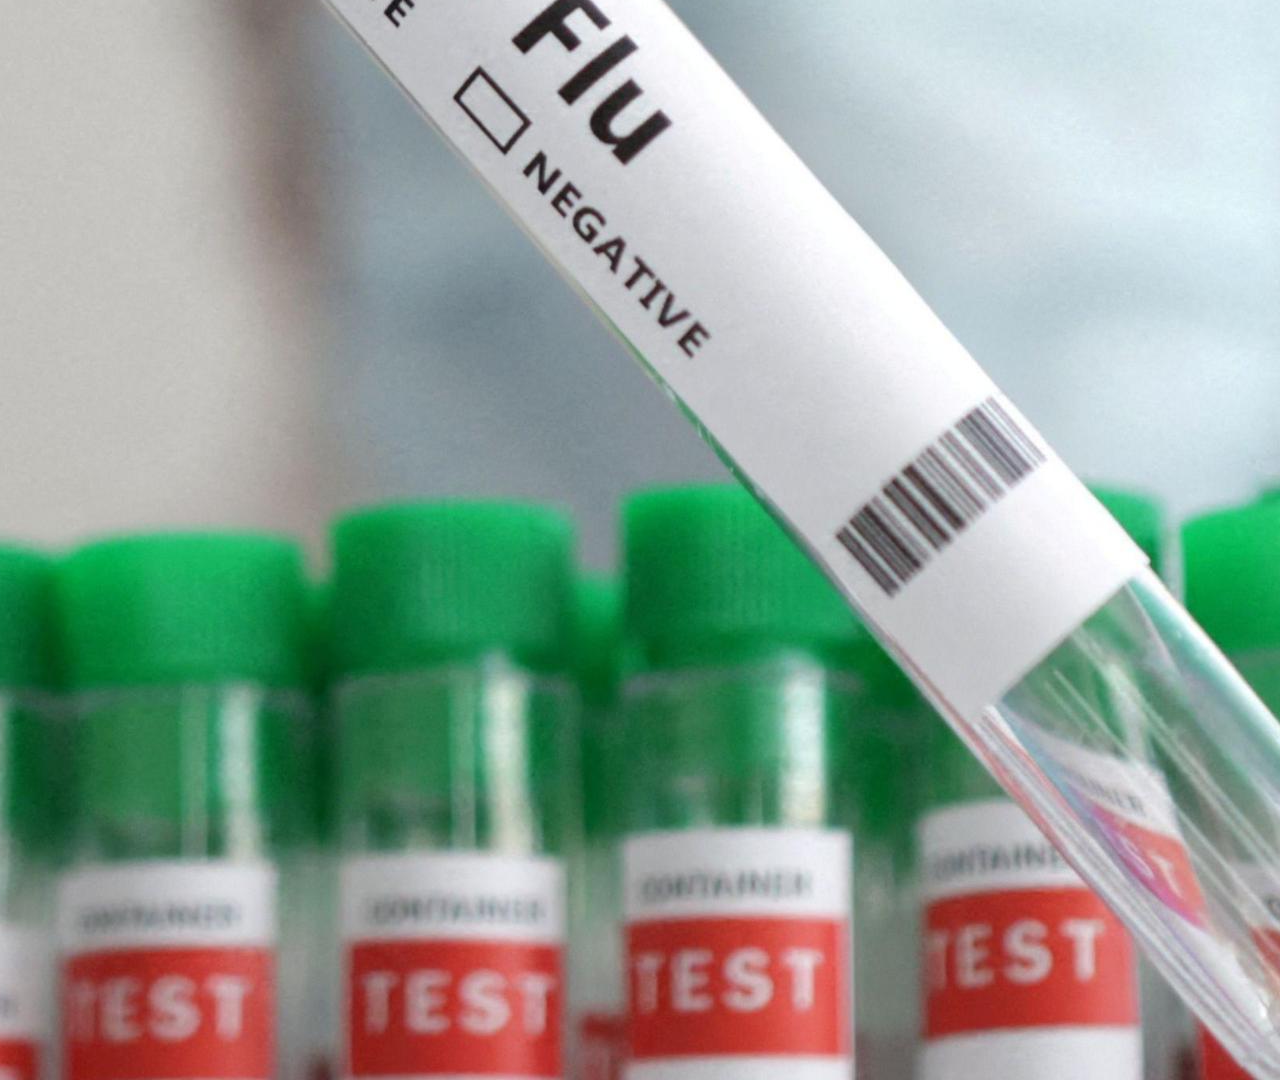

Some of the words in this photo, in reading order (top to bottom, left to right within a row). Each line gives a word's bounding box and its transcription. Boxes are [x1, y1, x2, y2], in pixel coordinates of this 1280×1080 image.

[522, 151, 712, 358] NEGATIVE
[361, 968, 557, 1037] TEST
[632, 947, 827, 1013] TEST
